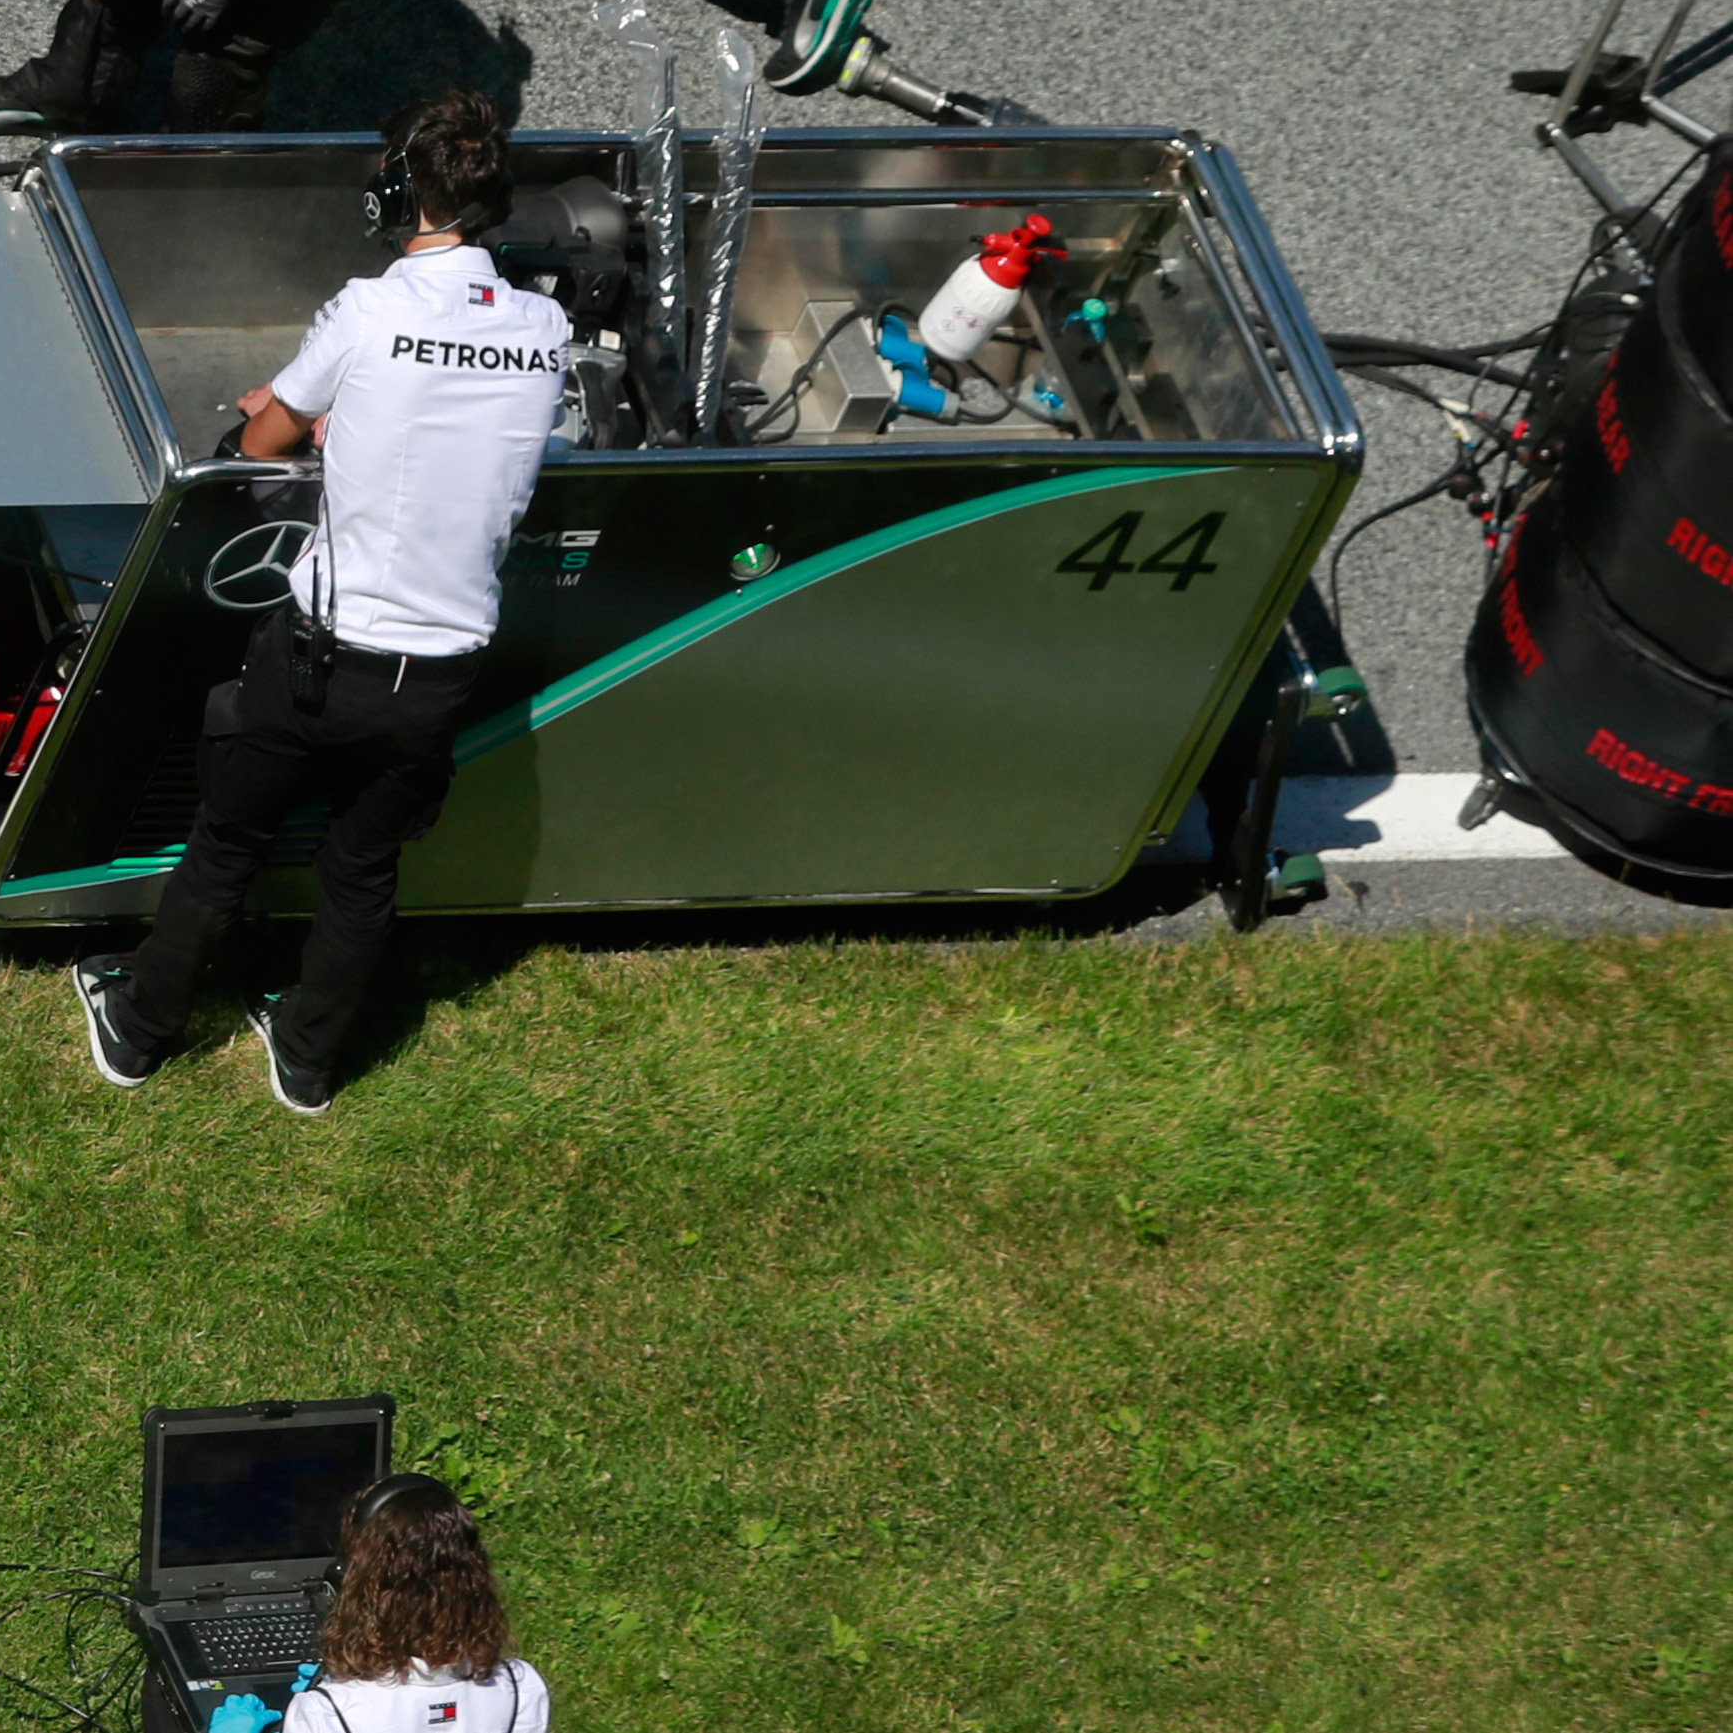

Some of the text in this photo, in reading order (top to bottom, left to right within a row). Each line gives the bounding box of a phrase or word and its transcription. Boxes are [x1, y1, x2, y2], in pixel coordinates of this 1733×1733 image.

[390, 334, 561, 374] PETRONAS
[512, 529, 602, 548] MG
[1055, 511, 1228, 593] 44
[1585, 727, 1695, 802] RIGHT
